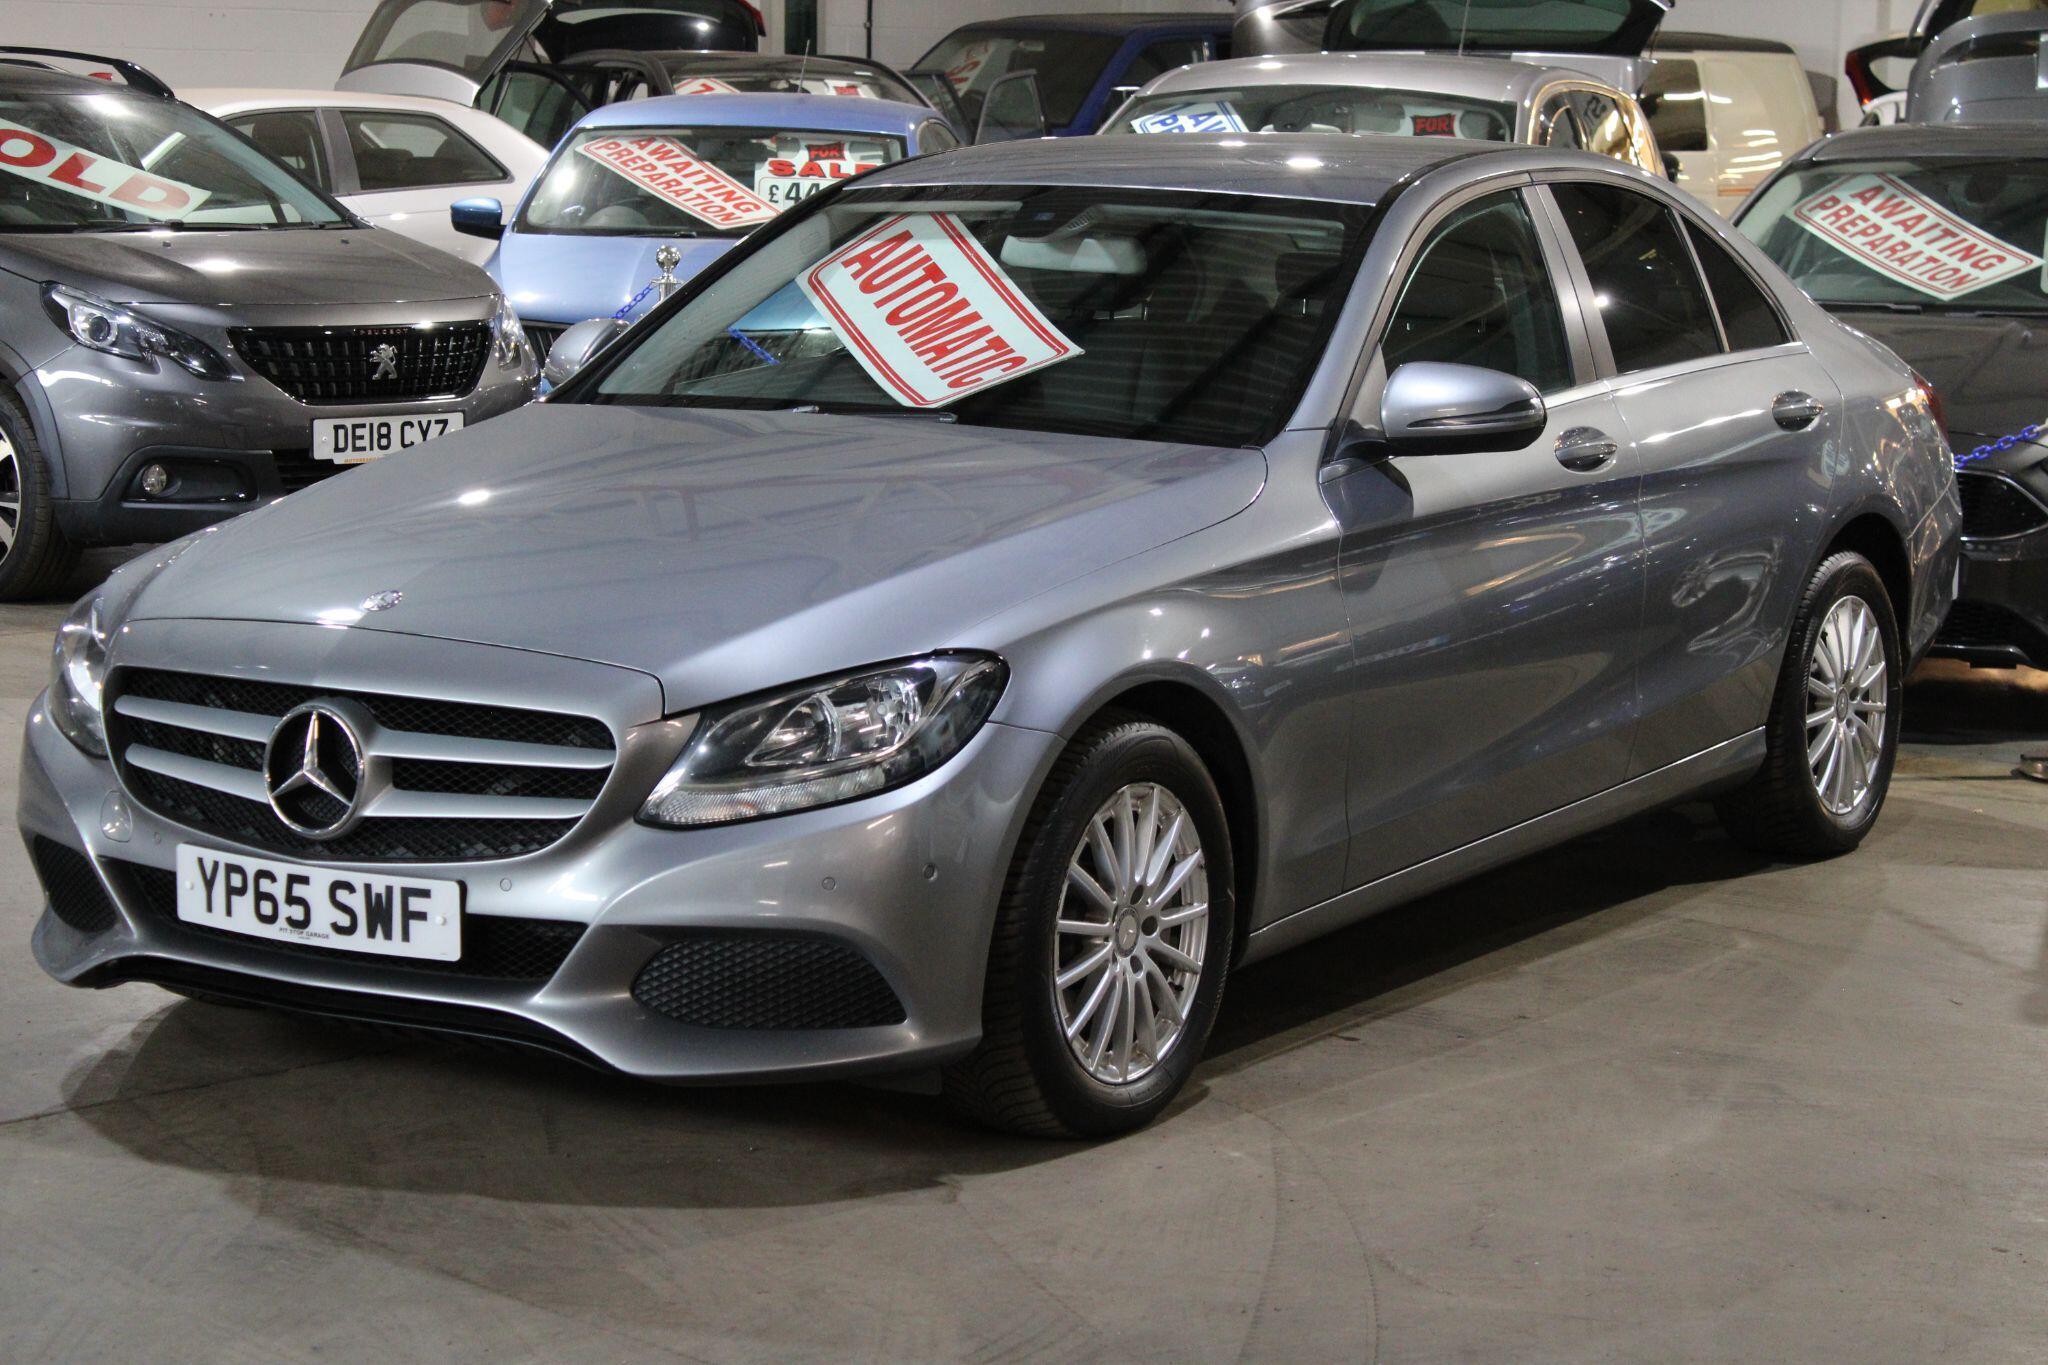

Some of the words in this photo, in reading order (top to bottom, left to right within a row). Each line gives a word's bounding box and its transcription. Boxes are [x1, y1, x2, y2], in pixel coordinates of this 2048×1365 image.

[595, 141, 742, 222] PREPARATION
[630, 136, 761, 213] AWAITING
[1807, 195, 1980, 288] PREPARATION
[1851, 184, 2007, 272] AWAITING
[841, 229, 1028, 389] AUTOMATIC
[333, 422, 391, 453] DE18
[197, 856, 311, 930] YP65
[328, 879, 432, 943] SWF
